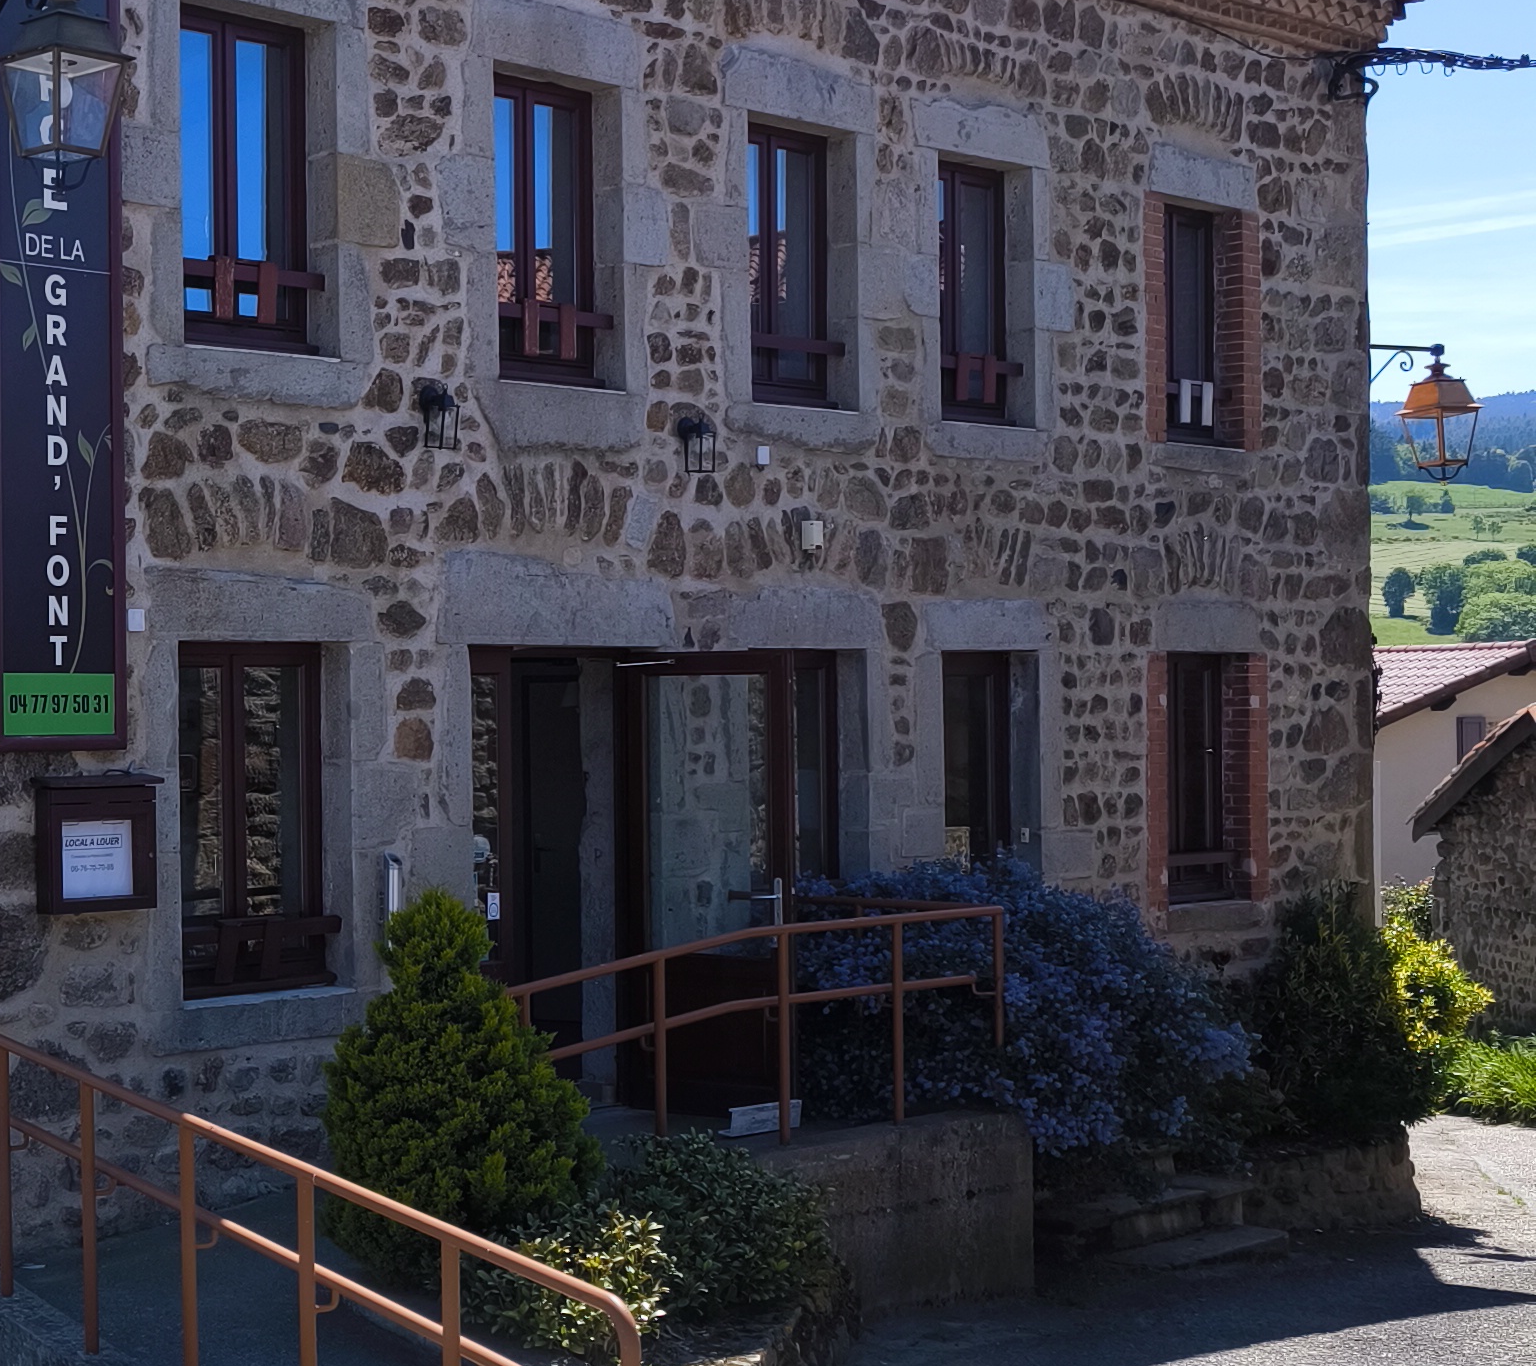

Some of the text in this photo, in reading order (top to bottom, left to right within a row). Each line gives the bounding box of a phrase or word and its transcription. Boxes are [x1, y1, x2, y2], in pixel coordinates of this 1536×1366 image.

[25, 232, 85, 263] DE LA
[9, 694, 109, 714] 04 77 97 50 31
[65, 836, 120, 848] LOCAL A LOUER
